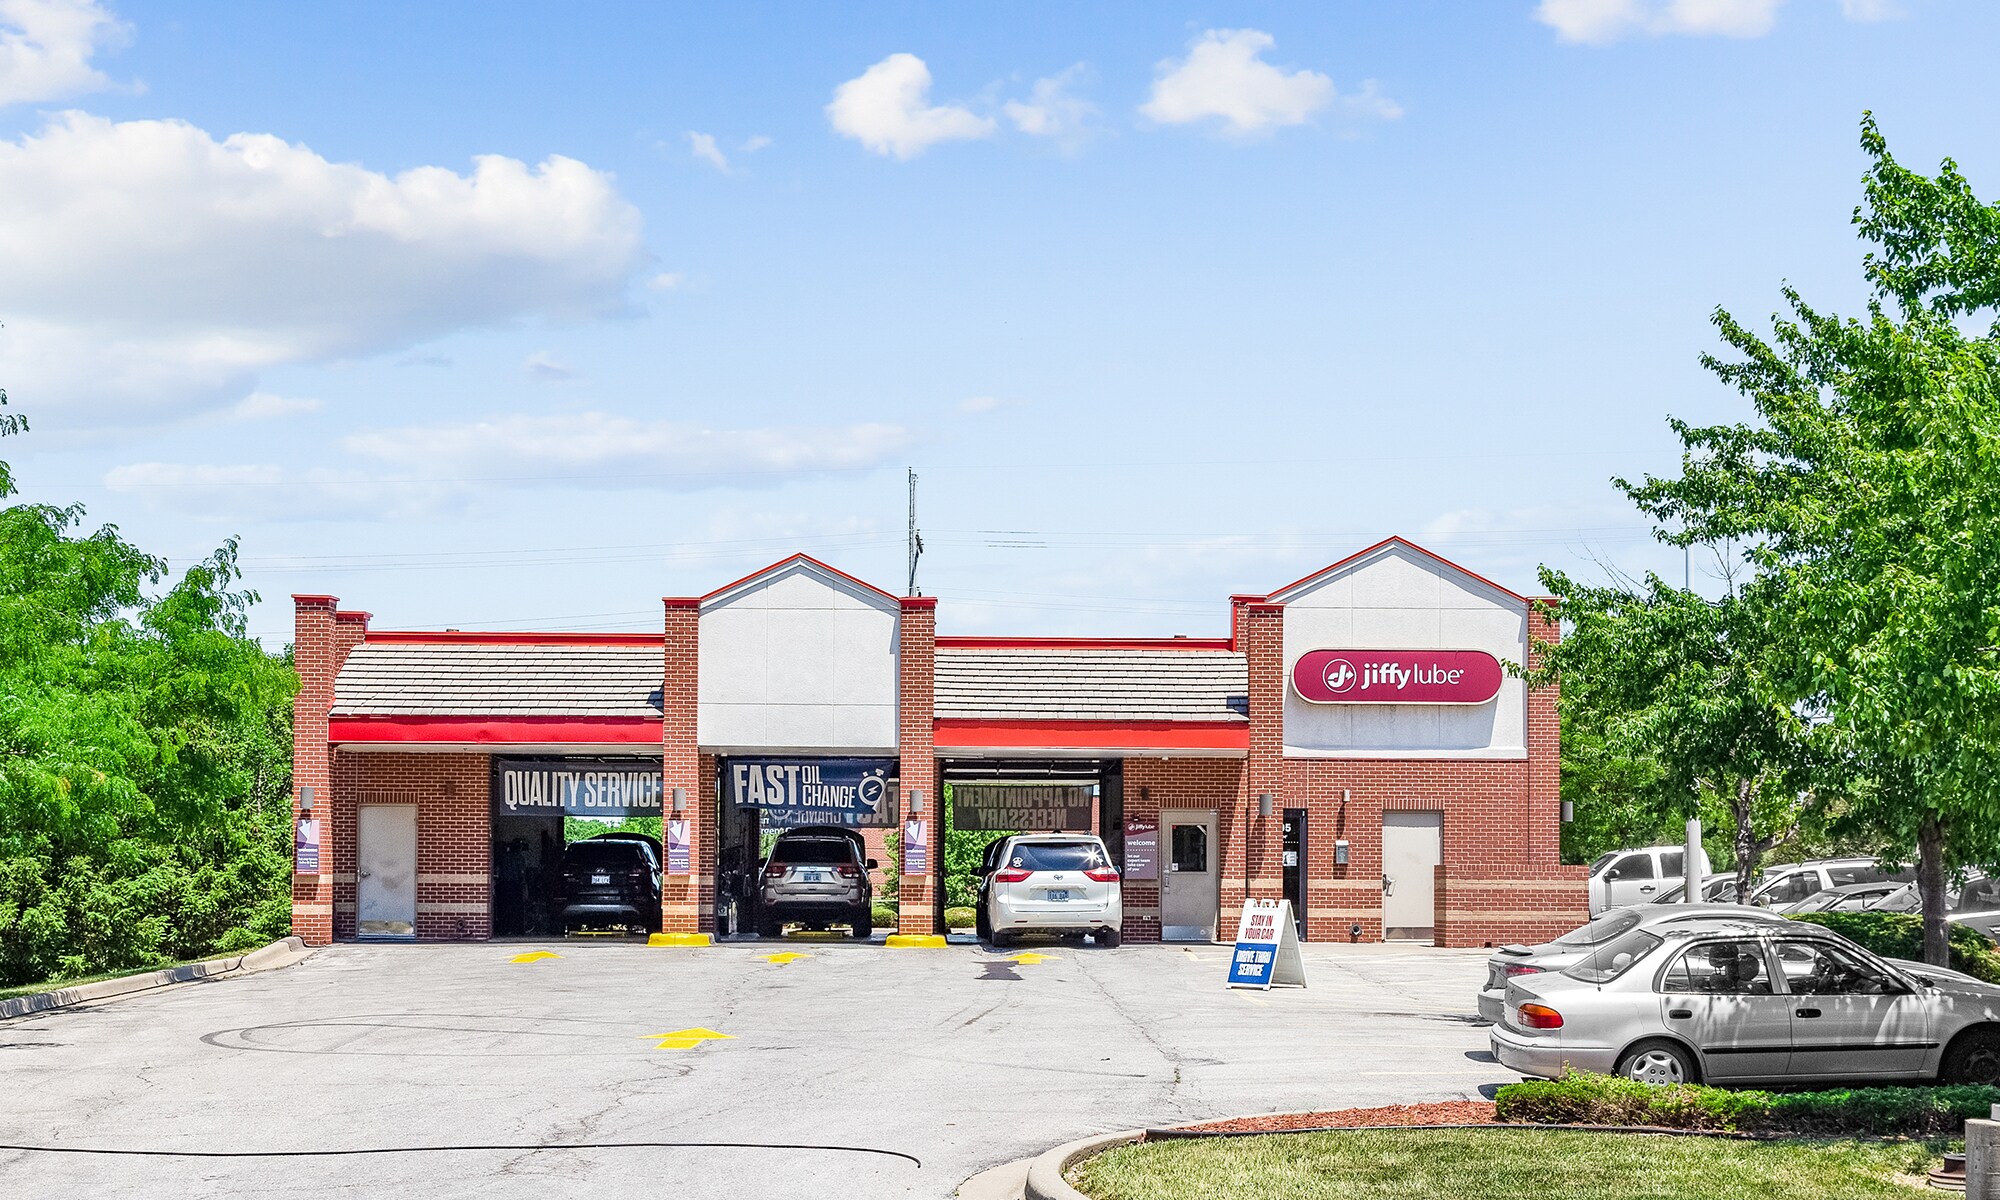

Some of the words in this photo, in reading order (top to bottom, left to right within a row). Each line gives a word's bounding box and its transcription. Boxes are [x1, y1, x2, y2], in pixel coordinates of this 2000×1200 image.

[1361, 663, 1411, 689] jiffy
[1414, 663, 1461, 685] lube
[733, 764, 800, 806] FAST
[802, 765, 823, 785] OIL
[504, 770, 580, 810] QUALITY
[585, 772, 662, 808] SERVICE
[802, 785, 857, 809] CHANGE
[1250, 915, 1265, 927] STAY
[1265, 915, 1273, 927] IN
[1244, 928, 1261, 939] YOUR
[1261, 928, 1274, 940] CAR
[1235, 950, 1256, 963] DRIVE
[1255, 951, 1272, 964] THRU
[1238, 963, 1264, 977] SERVICE
